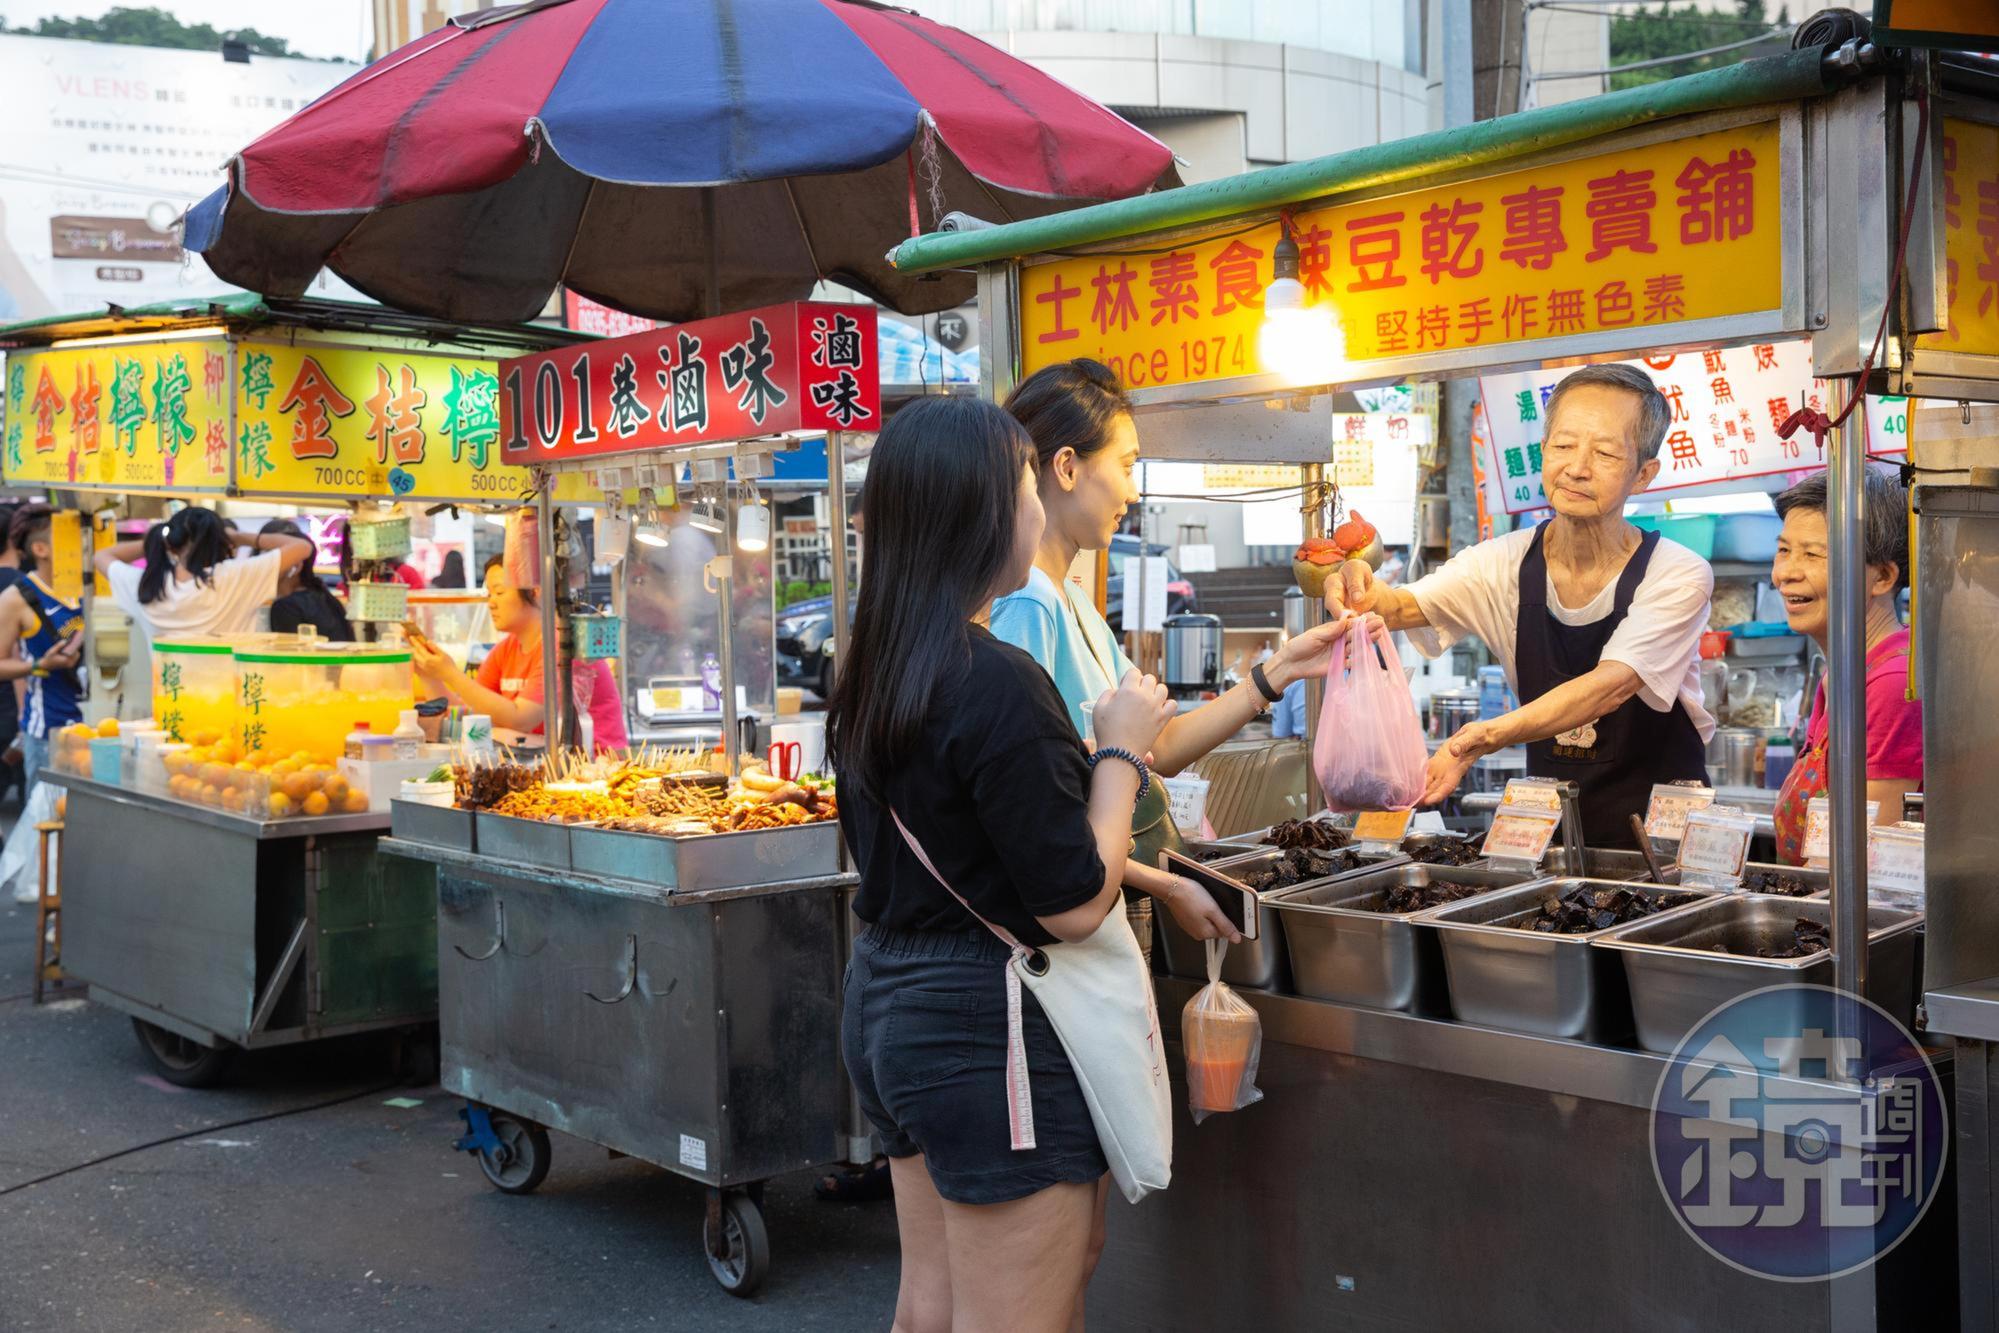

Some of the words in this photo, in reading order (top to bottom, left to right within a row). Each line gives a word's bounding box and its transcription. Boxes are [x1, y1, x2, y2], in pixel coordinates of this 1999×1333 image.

[1376, 275, 1686, 352] 堅持手作無色素
[812, 313, 871, 425] 滷味
[1181, 334, 1245, 378] 1974
[506, 318, 787, 449] 101巷滷味
[31, 353, 195, 457] 金桔檸檬
[240, 351, 275, 478] 檸檬
[1884, 415, 1906, 434] 40
[1730, 448, 1749, 466] 70
[1781, 441, 1799, 459] 70
[314, 467, 365, 485] 700CC
[471, 474, 516, 491] 500CC
[1515, 485, 1530, 501] 40
